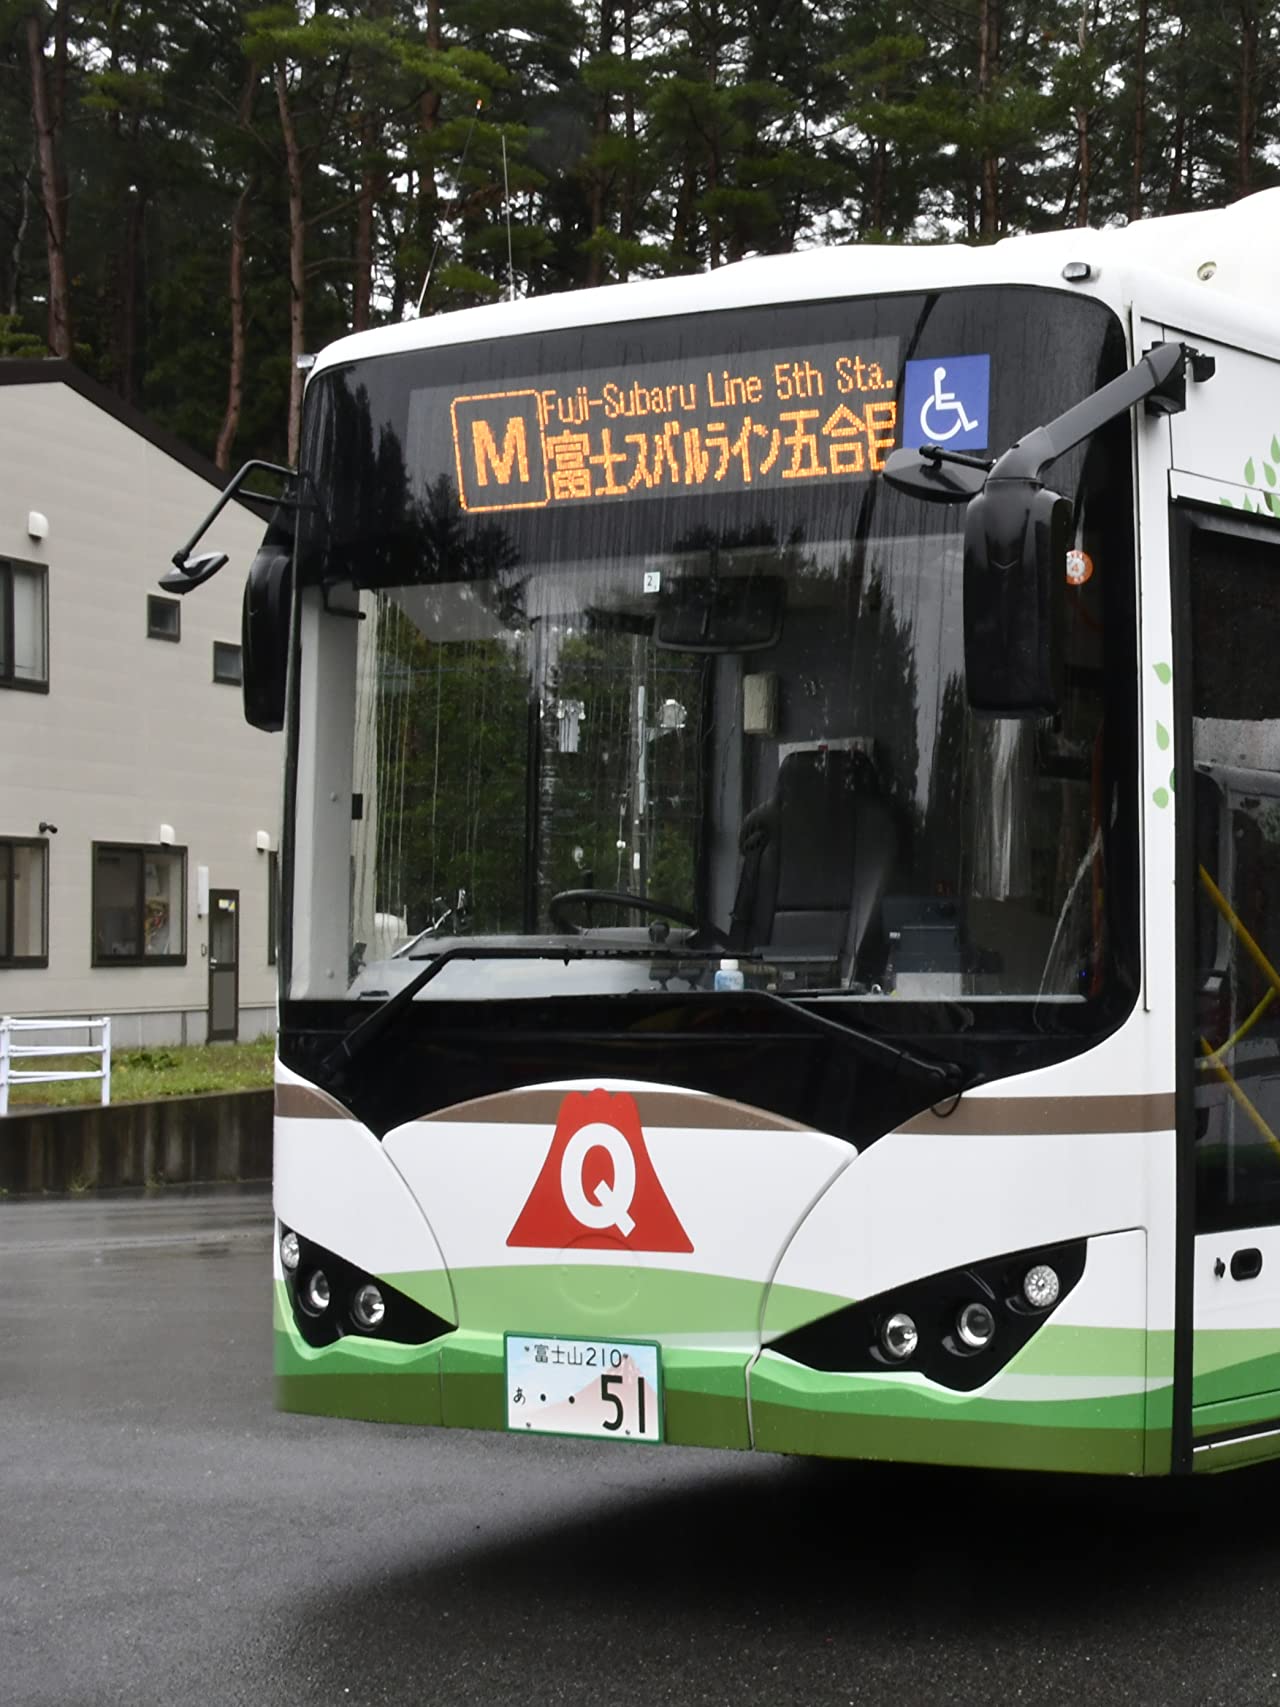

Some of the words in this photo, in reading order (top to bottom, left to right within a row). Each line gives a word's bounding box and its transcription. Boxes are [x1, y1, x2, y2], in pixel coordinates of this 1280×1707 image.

[542, 382, 698, 425] Fuji-Subaru
[707, 371, 763, 408] Line
[774, 361, 825, 401] 5th
[835, 354, 894, 393] Sta.
[472, 415, 529, 486] M
[546, 401, 897, 500] 富士スバルライン五合目
[560, 1122, 636, 1238] Q
[534, 1344, 622, 1368] 富士山210
